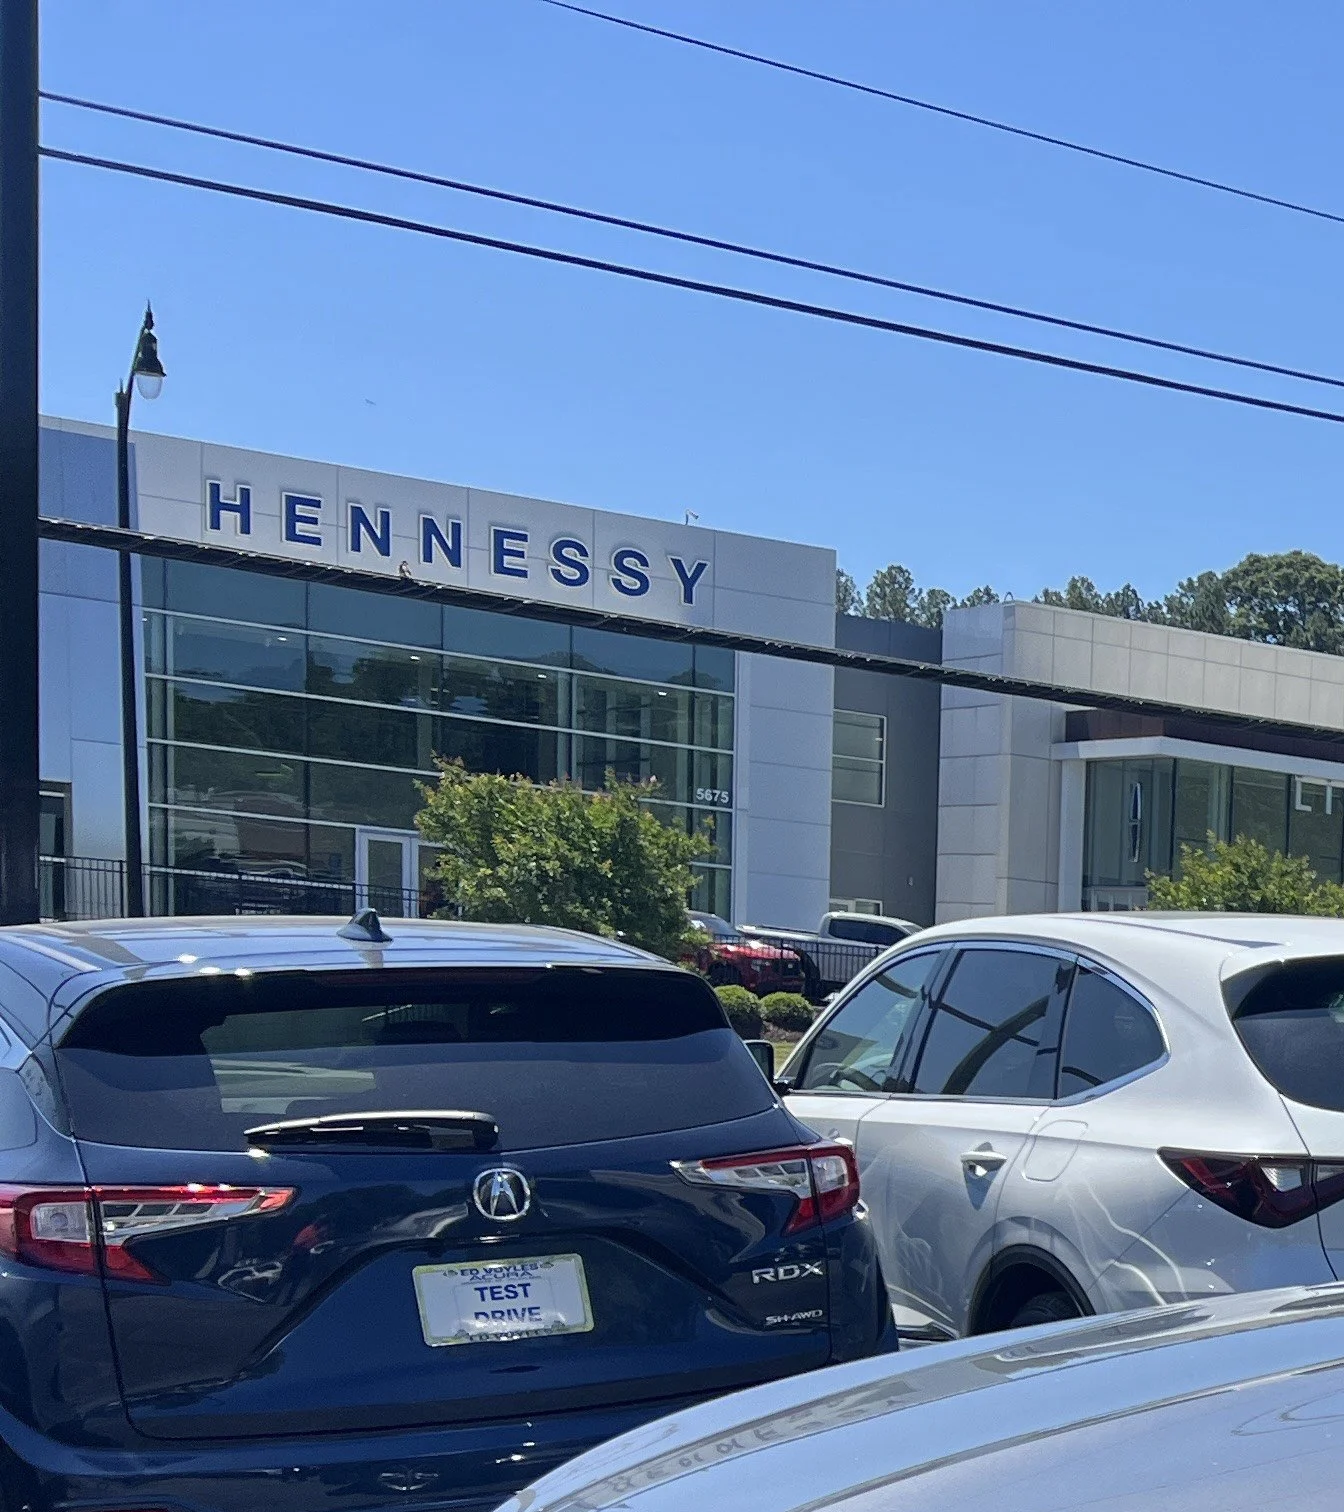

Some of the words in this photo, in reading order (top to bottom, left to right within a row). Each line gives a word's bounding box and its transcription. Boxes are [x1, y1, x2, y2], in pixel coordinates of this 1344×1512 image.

[205, 479, 710, 607] HENNESSY
[696, 787, 730, 804] 5675
[469, 1271, 533, 1281] ACURA
[752, 1261, 823, 1284] RDX
[474, 1282, 531, 1302] TEST
[474, 1306, 542, 1324] DRIVE
[765, 1309, 823, 1325] SH-AWD
